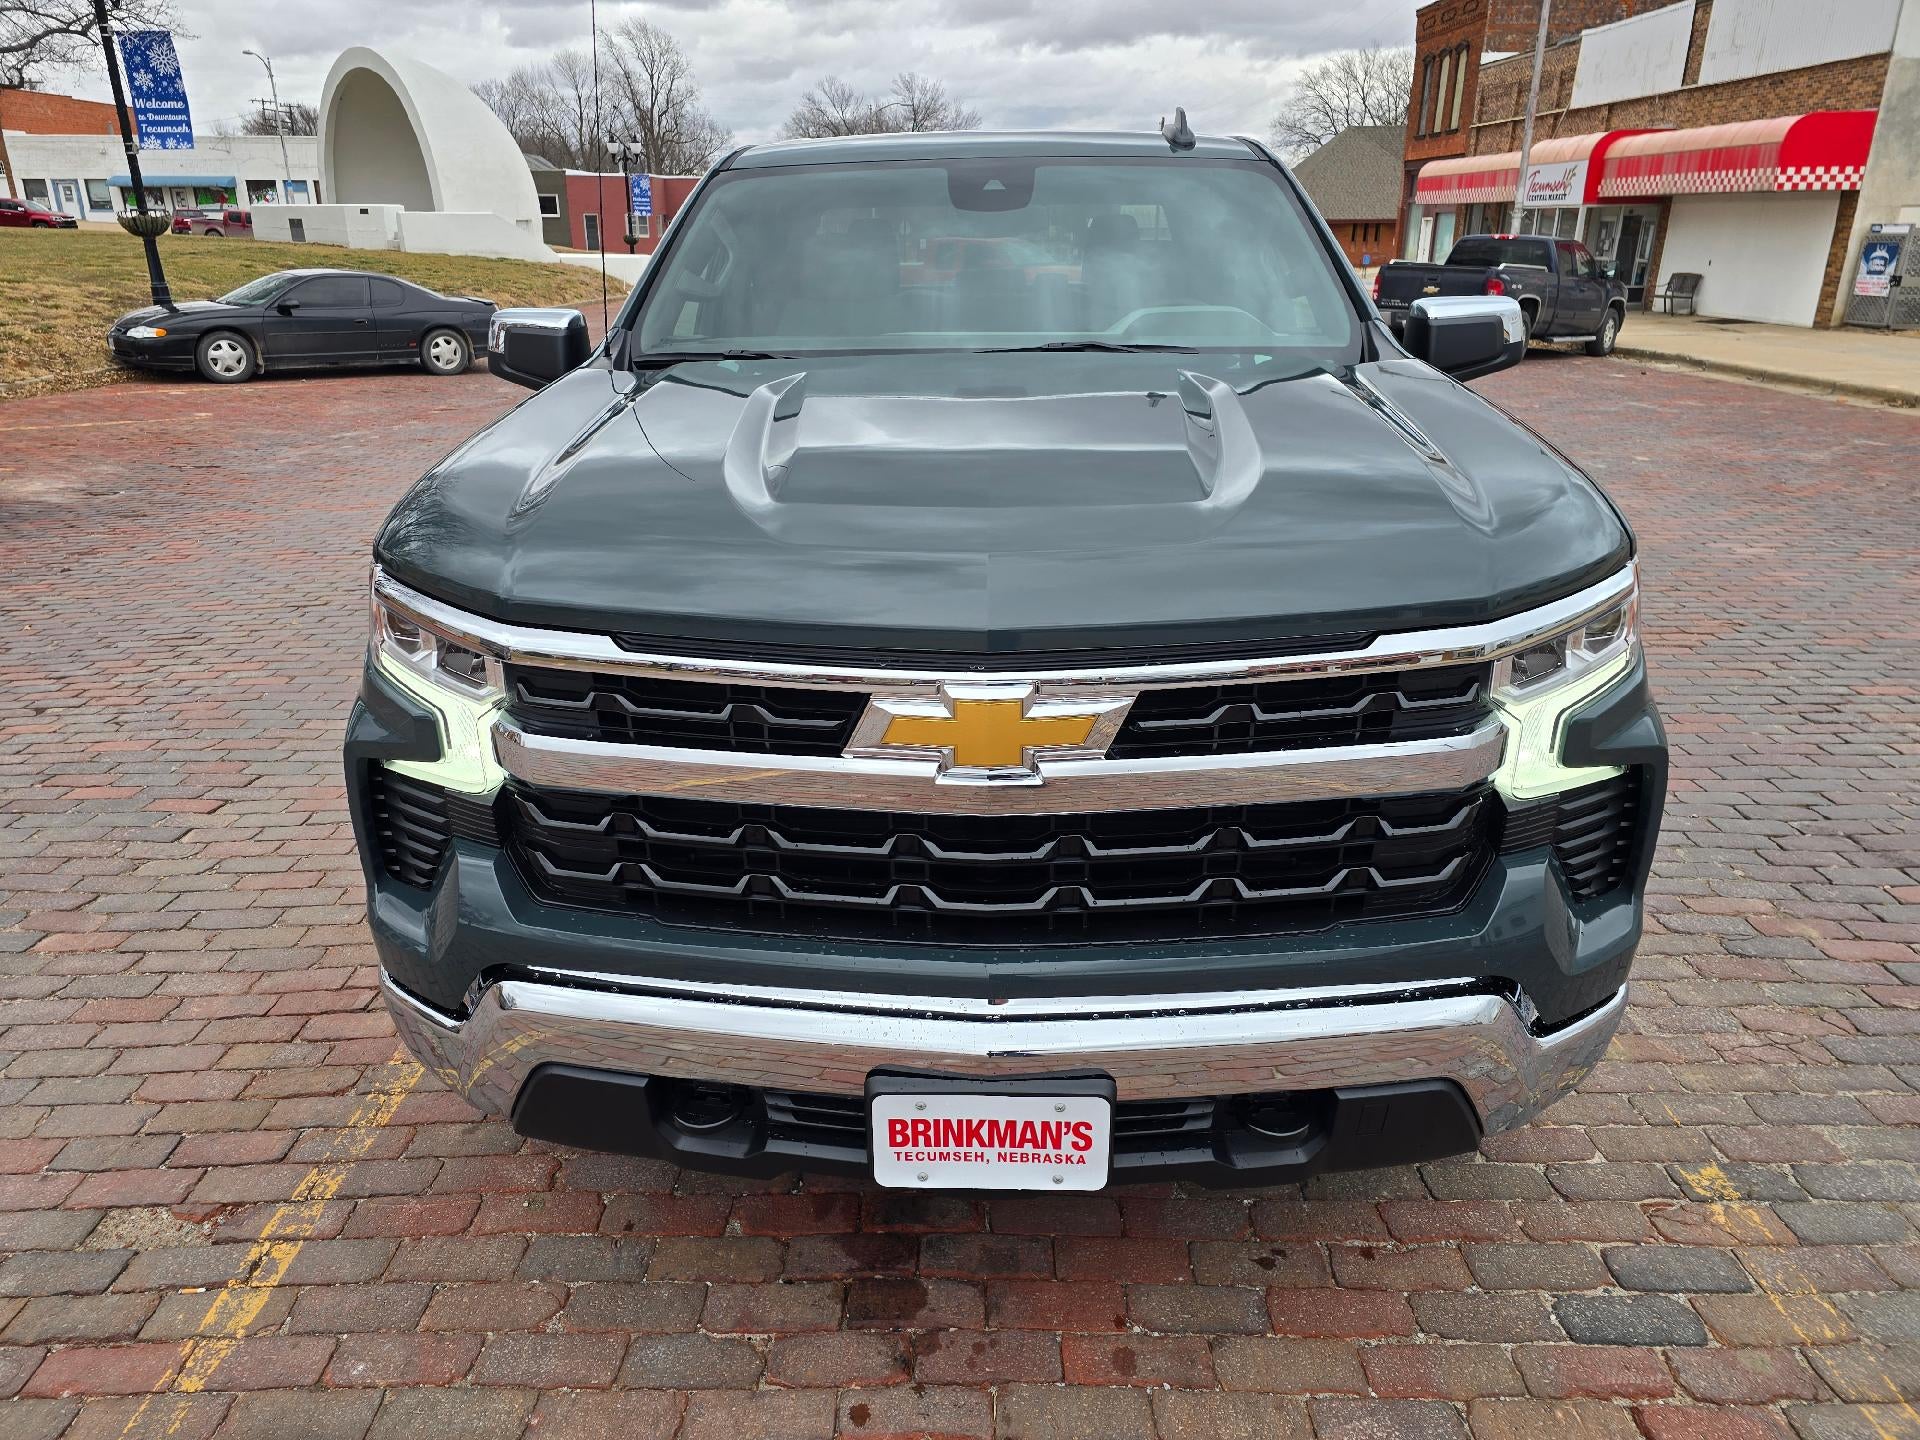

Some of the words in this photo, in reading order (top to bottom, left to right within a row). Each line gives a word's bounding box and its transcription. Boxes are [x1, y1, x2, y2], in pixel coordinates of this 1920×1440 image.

[135, 98, 185, 109] Welcome
[147, 113, 188, 121] Downtown
[141, 123, 190, 133] Tecumseh
[1527, 168, 1568, 202] Tecumseh
[1528, 194, 1547, 202] CENTRAL
[1548, 193, 1567, 201] MARKET
[888, 1118, 1093, 1152] BRINKMAN'S
[894, 1152, 990, 1165] TECUMSEH,
[997, 1152, 1087, 1165] NEBRASKA
